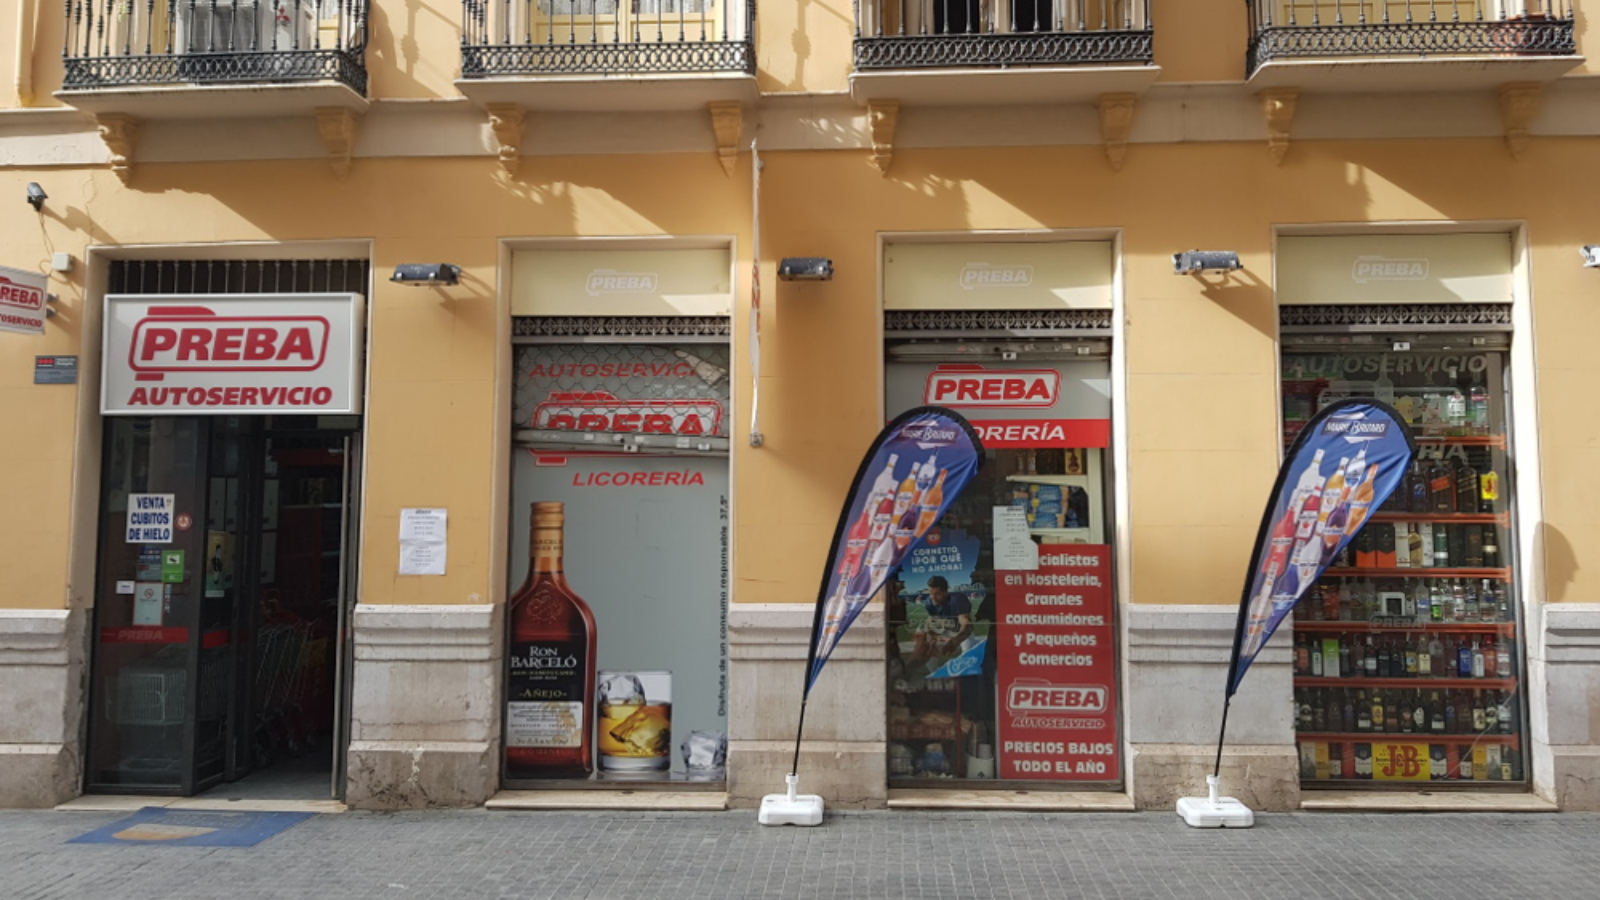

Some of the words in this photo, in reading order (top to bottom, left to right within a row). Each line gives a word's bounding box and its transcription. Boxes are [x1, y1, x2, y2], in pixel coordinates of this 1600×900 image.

[965, 270, 1028, 283] PREBA
[1357, 263, 1423, 276] PREBA
[591, 276, 652, 289] PREBA
[0, 286, 39, 305] REBA
[140, 328, 314, 360] PREBA
[1290, 354, 1488, 372] AUTOSERVICIO
[127, 387, 332, 406] AUTOSERVICIO
[935, 379, 1050, 400] PREBA
[973, 422, 1066, 441] ORERÍA
[572, 469, 705, 486] LICORERÍA
[137, 496, 165, 509] VENTA
[131, 512, 169, 525] CUBITOS
[128, 528, 141, 540] DE
[142, 528, 170, 540] HIELO
[1040, 553, 1098, 566] cialistas
[1004, 576, 1022, 585] en
[1025, 593, 1083, 605] Grandes
[1006, 613, 1104, 625] consumidores
[1014, 636, 1021, 646] y
[1026, 632, 1096, 646] Pequeños
[530, 646, 558, 657] RON
[720, 642, 726, 656] un
[511, 654, 577, 669] BARCELÓ
[718, 659, 726, 672] de
[1019, 652, 1093, 666] Comercios
[523, 688, 562, 699] AÑEJO
[1013, 690, 1101, 707] PREBA
[1011, 716, 1105, 729] AUTOSERVICIO
[1004, 741, 1066, 754] PRECIOS
[1068, 742, 1114, 755] BAJOS
[1013, 761, 1051, 772] TODO
[1055, 761, 1072, 772] EL
[1076, 759, 1105, 774] AÑO
[1382, 745, 1421, 777] J&B
